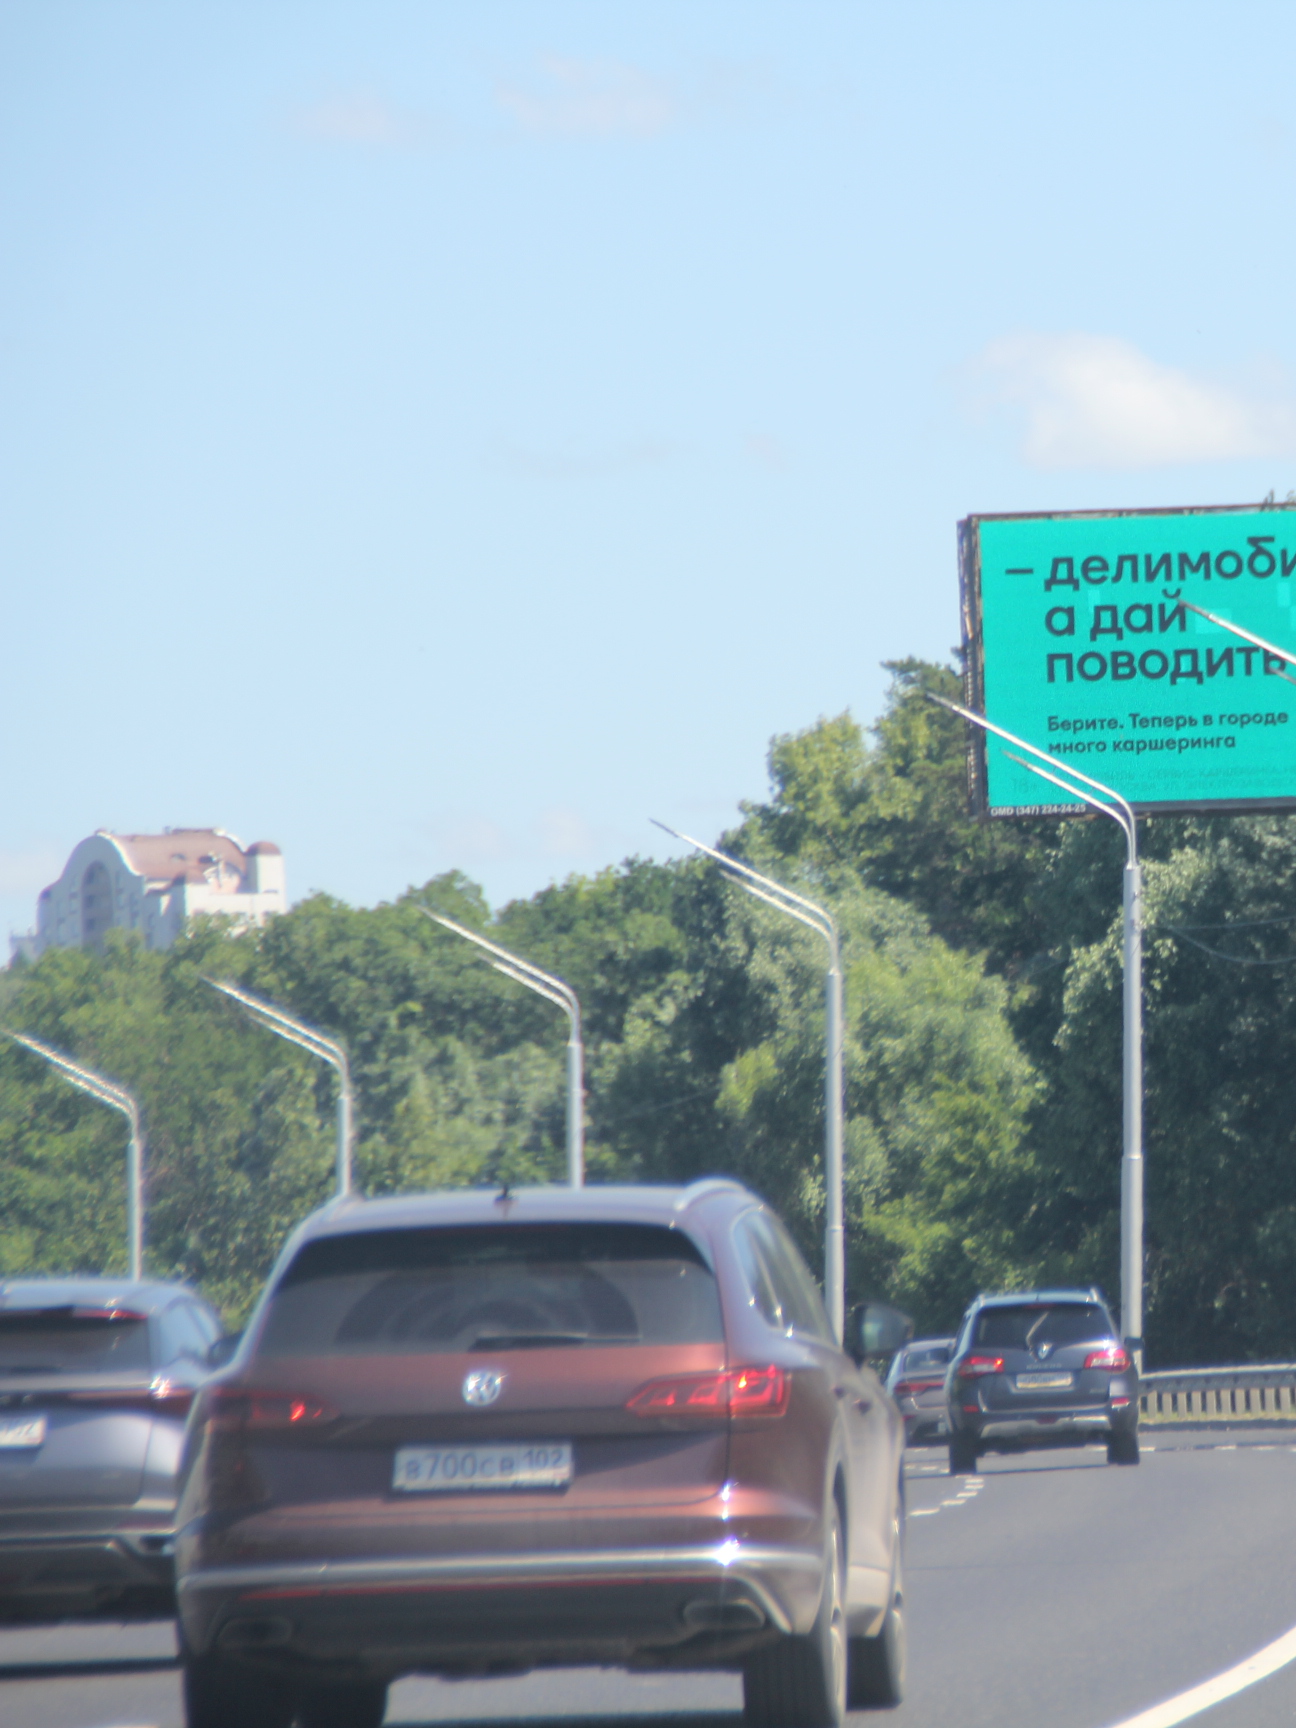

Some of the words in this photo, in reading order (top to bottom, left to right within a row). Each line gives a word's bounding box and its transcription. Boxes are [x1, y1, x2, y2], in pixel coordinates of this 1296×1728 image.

[1045, 605, 1075, 637] а
[1090, 588, 1187, 642] дай
[1047, 645, 1287, 686] поводить
[1047, 715, 1124, 734] Берите.
[1128, 712, 1198, 731] Теперь
[1203, 714, 1214, 727] в
[1219, 711, 1289, 728] городе
[1048, 739, 1107, 754] много
[1112, 734, 1237, 755] каршеринга
[1016, 804, 1040, 817] (347)
